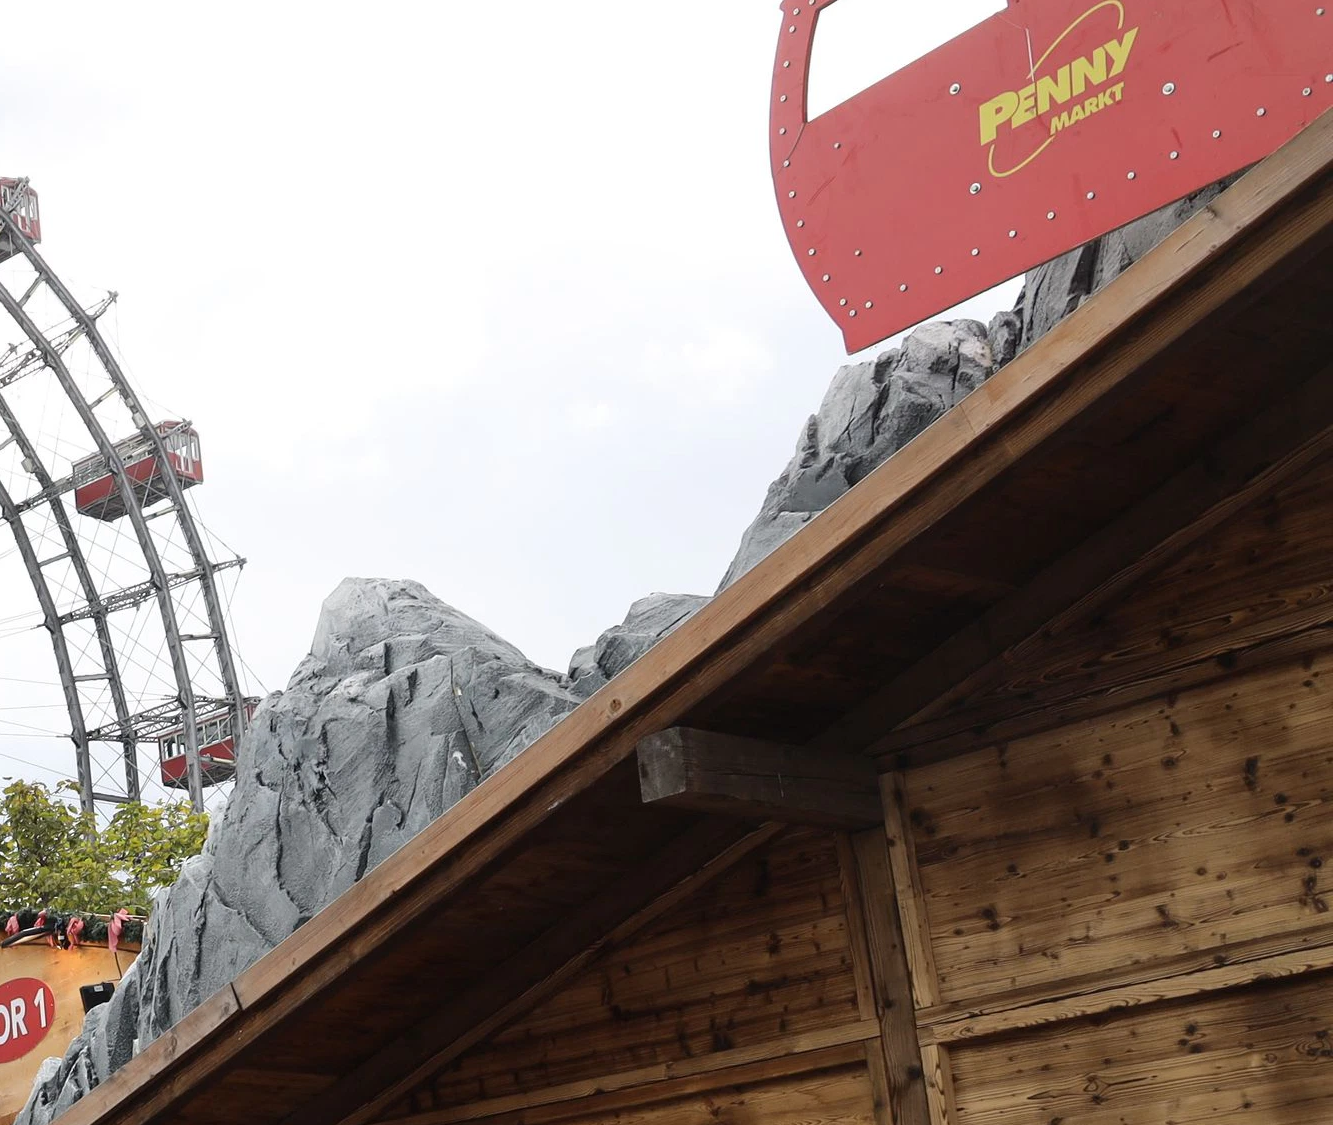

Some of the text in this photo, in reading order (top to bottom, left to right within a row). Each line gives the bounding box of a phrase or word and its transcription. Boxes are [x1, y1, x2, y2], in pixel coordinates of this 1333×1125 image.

[979, 26, 1139, 146] PENNY
[1050, 81, 1125, 136] MARKT
[33, 987, 47, 1029] 1
